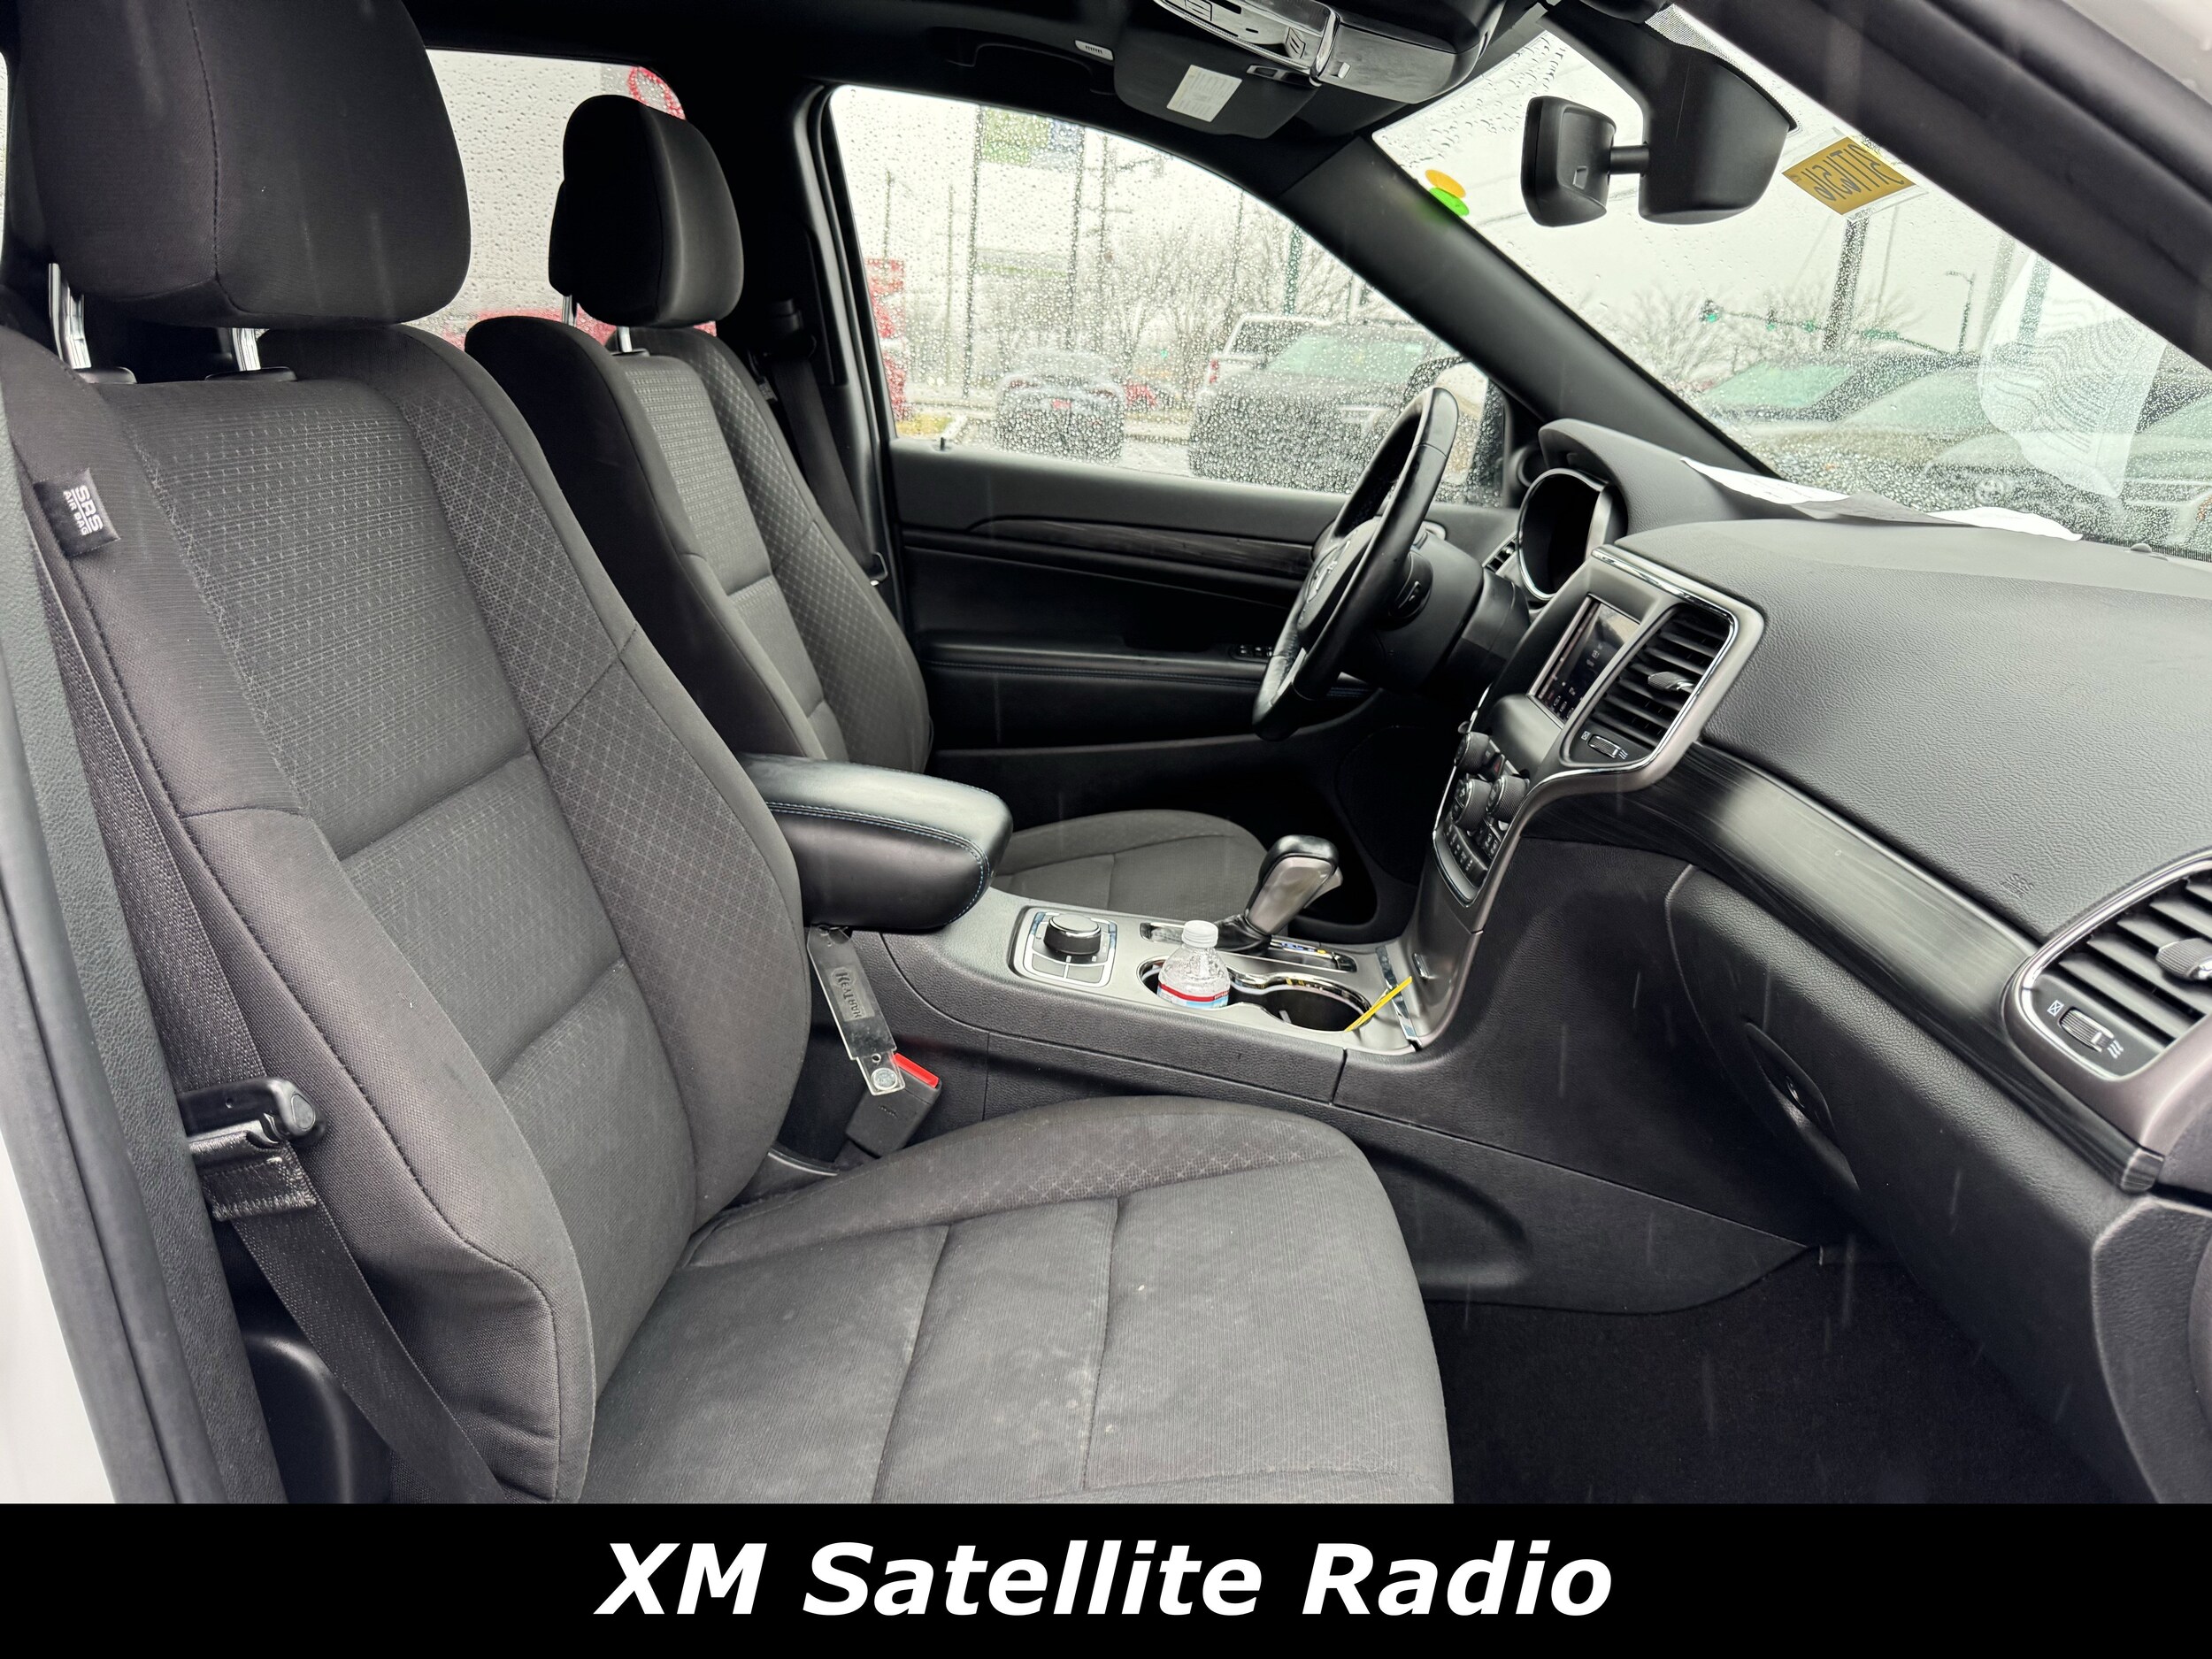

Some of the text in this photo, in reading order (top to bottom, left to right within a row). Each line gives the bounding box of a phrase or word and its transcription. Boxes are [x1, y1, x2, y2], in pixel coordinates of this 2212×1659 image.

[63, 490, 89, 536] AIR BAG
[75, 484, 104, 532] SRS
